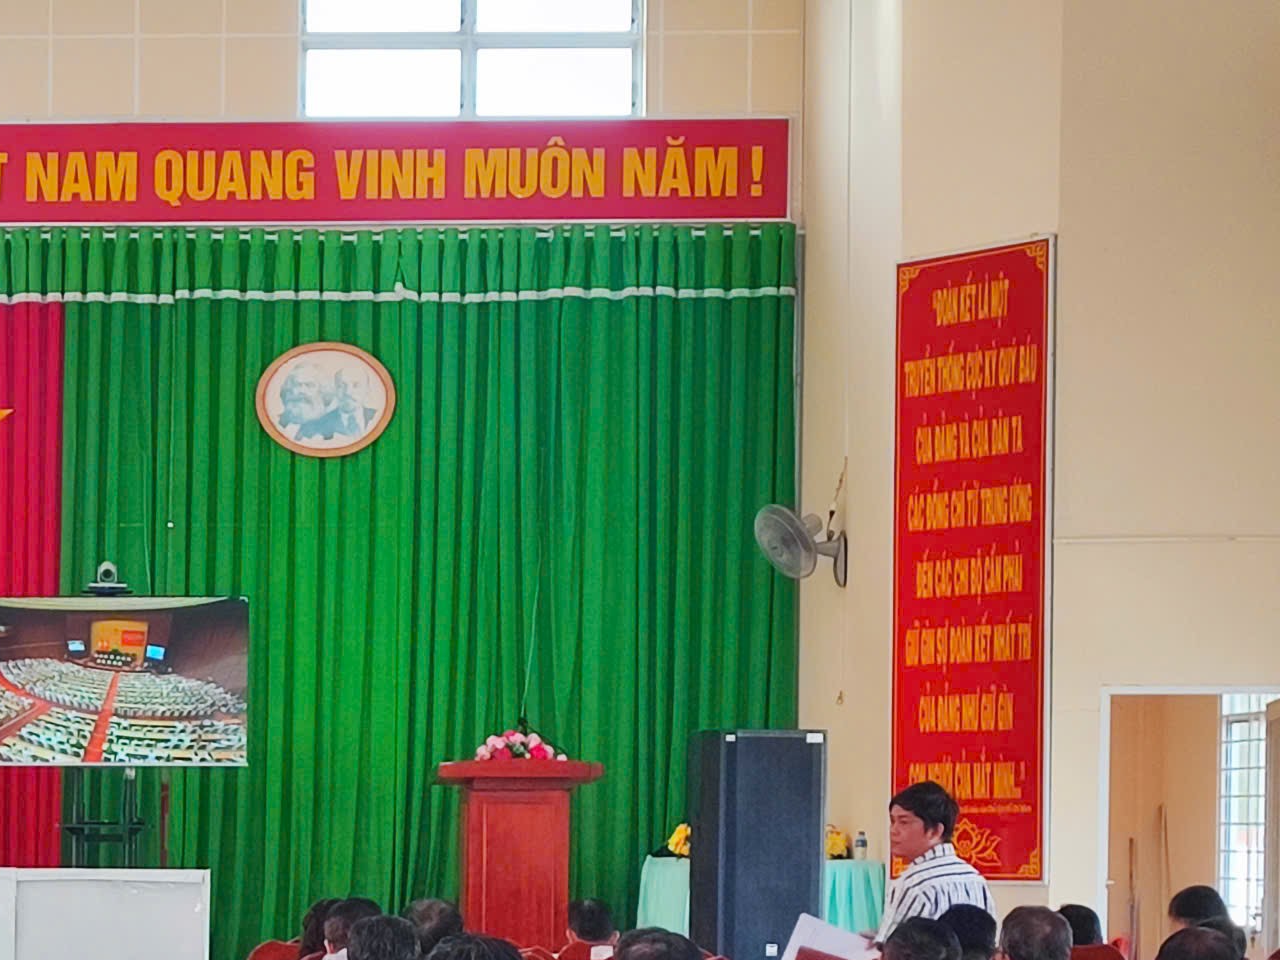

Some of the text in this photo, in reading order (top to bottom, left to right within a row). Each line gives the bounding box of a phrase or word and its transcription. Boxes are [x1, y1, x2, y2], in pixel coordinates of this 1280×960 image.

[26, 150, 138, 202] NAM
[154, 149, 315, 206] QUANG
[334, 148, 445, 199] VINH
[464, 136, 605, 198] MUÔN
